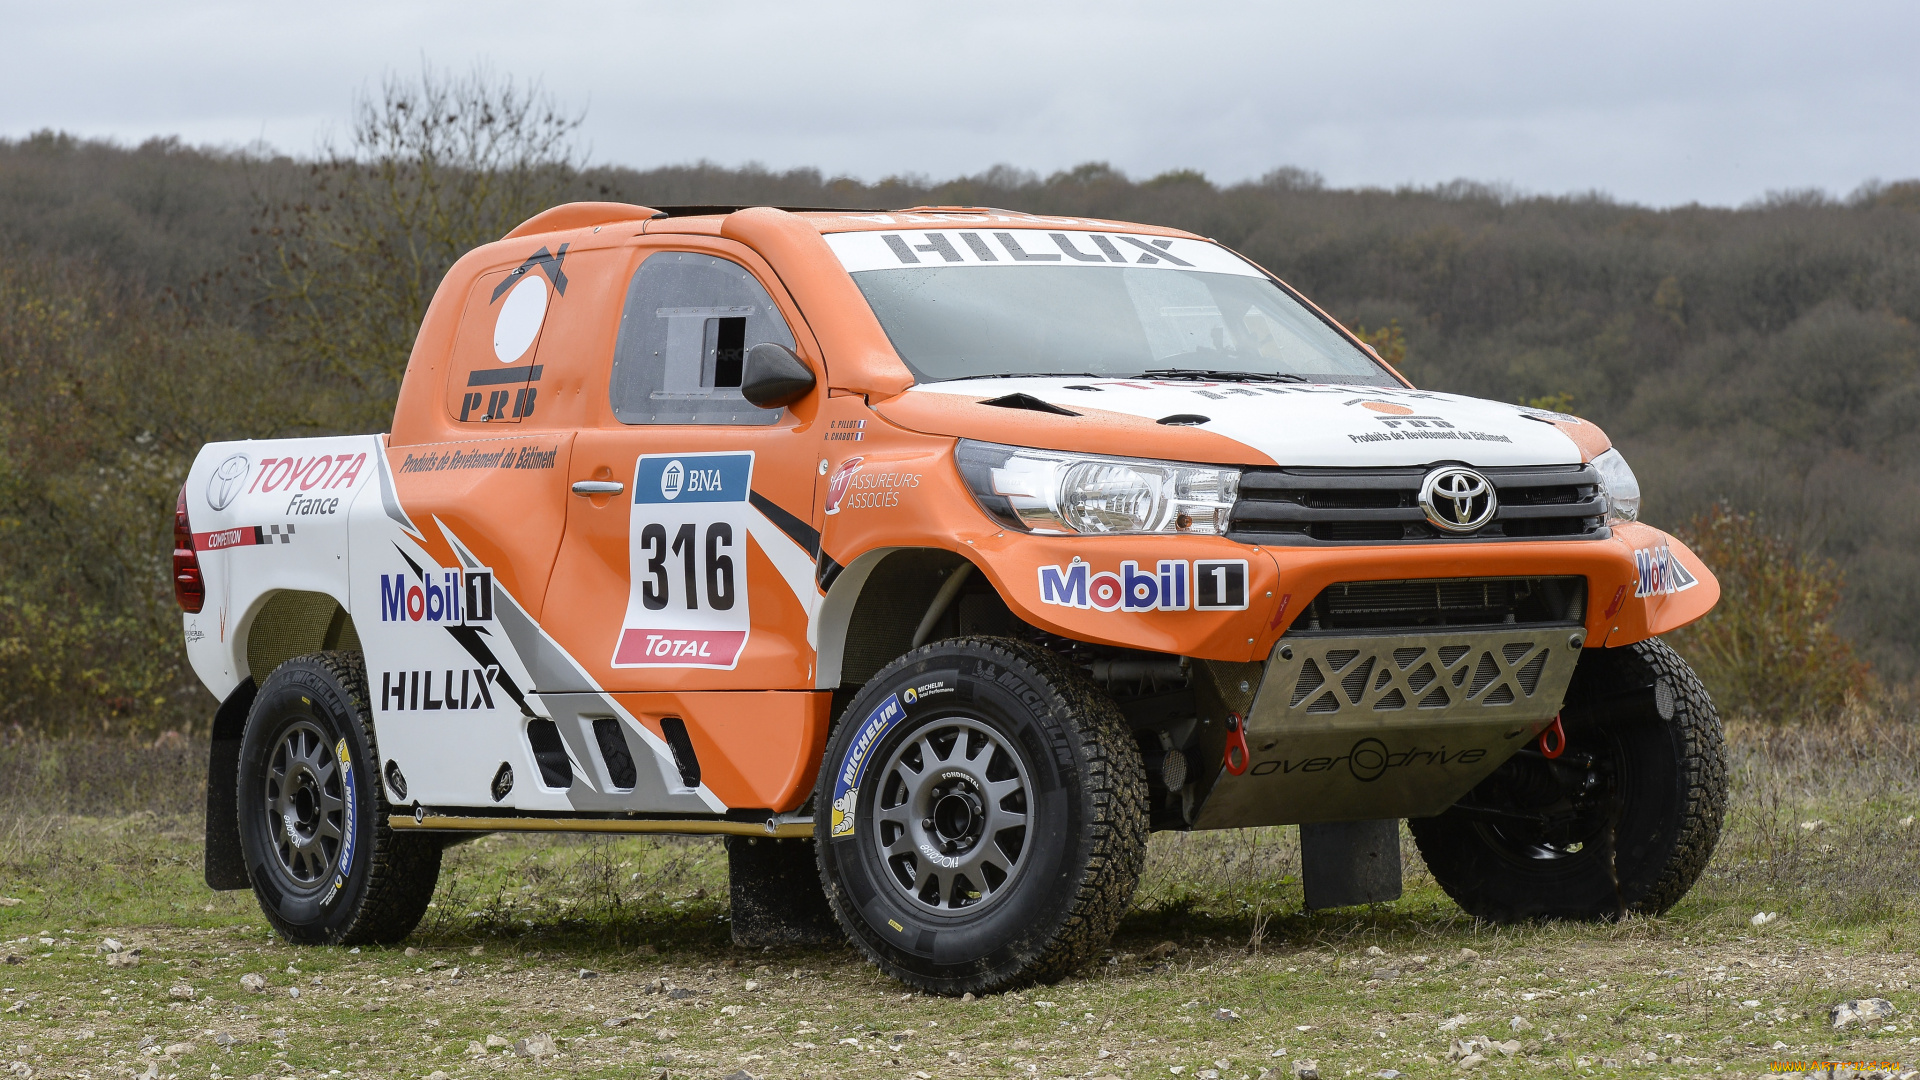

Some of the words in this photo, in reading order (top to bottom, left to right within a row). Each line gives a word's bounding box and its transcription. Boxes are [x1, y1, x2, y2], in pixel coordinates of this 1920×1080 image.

[880, 232, 1196, 267] HILUX
[460, 387, 538, 422] PRB
[837, 420, 857, 429] PILLOT
[1348, 431, 1391, 444] Produits
[1390, 432, 1405, 441] de
[1458, 430, 1473, 441] du
[1382, 420, 1456, 429] PRB
[248, 452, 367, 494] TOYOTA
[399, 452, 438, 474] Produits
[436, 451, 450, 470] de
[450, 447, 501, 470] Revêtement
[503, 449, 518, 469] du
[514, 444, 558, 470] Bâtiment
[687, 469, 723, 492] BNA
[850, 472, 923, 489] ASSUREURS
[286, 493, 340, 516] France
[847, 487, 900, 509] ASSOCIÉS
[640, 522, 735, 611] 316
[380, 572, 460, 622] Mobil
[469, 575, 489, 620] 1
[1041, 563, 1186, 608] Mobil
[1209, 565, 1229, 605] 1
[645, 635, 711, 658] TOTAL
[291, 669, 345, 717] MICHELIN
[381, 666, 498, 711] HILUX
[918, 681, 944, 693] MICHELIN
[997, 670, 1076, 766] MICHELIN
[843, 701, 898, 786] MICHELIN
[941, 771, 980, 790] FONDMETAL
[342, 785, 353, 871] MICHELIN
